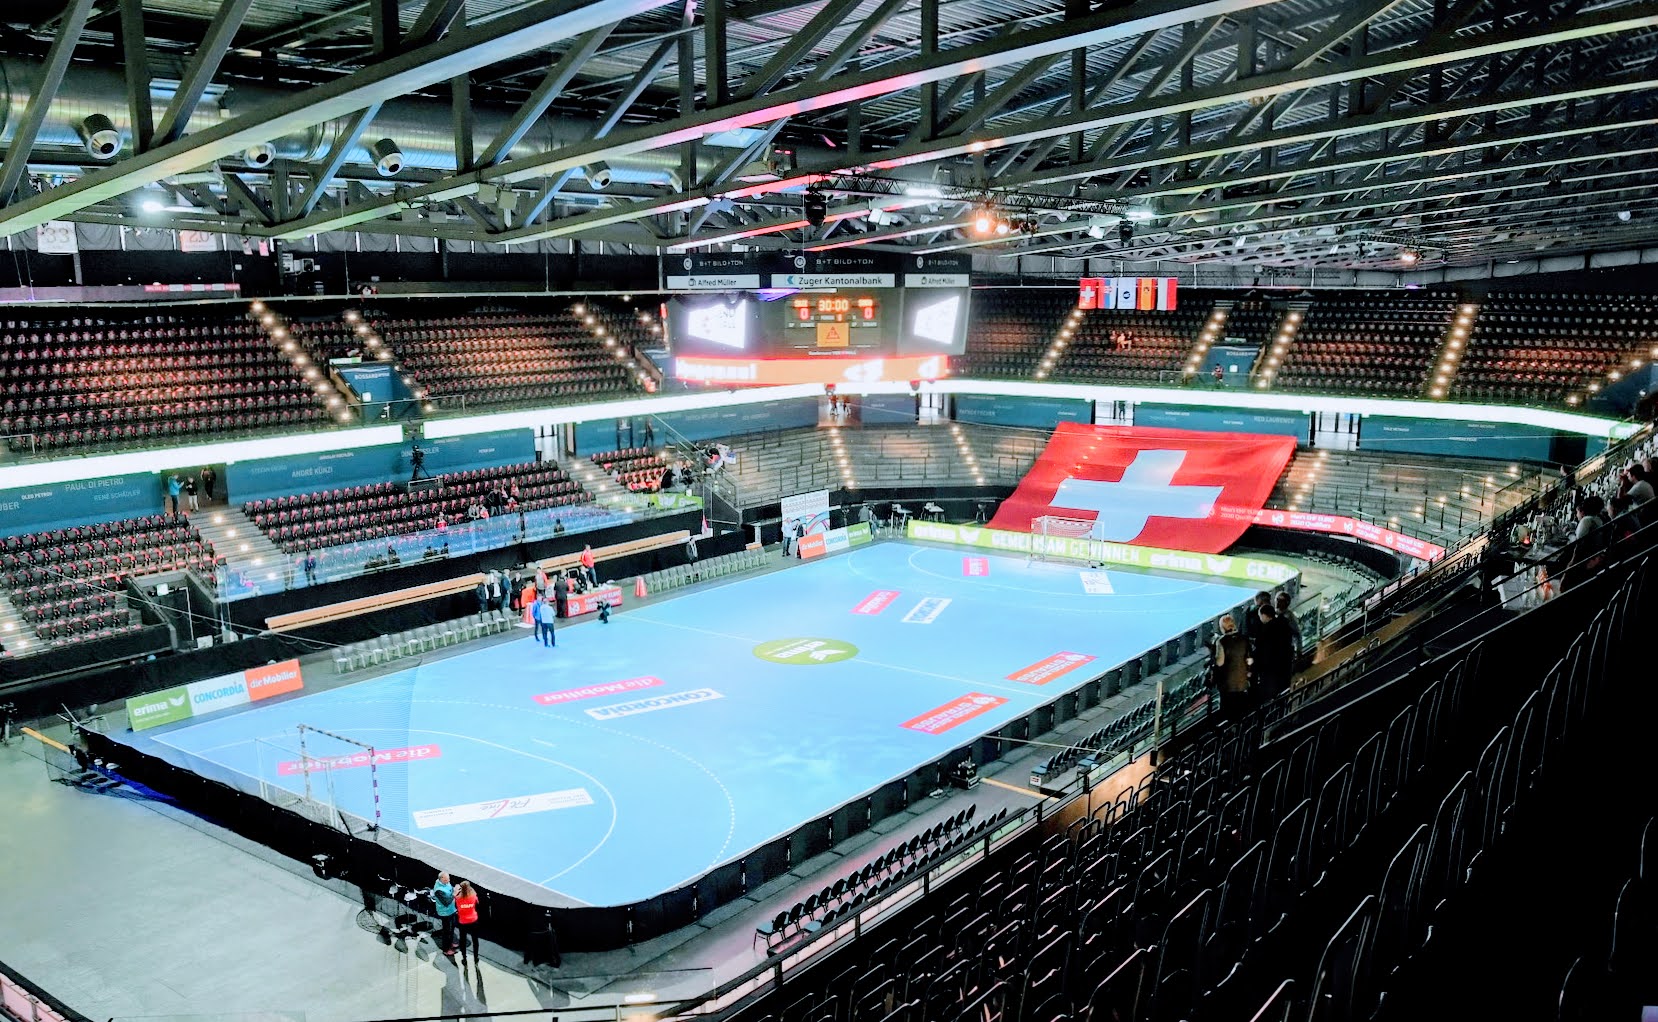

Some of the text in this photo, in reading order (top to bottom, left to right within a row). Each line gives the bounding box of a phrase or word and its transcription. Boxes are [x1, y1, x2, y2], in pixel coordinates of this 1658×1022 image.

[697, 278, 737, 287] Alfred Müller
[798, 276, 883, 287] Zuger Kantonalbank
[818, 299, 849, 311] 30:00
[800, 307, 809, 320] 0
[864, 307, 873, 319] 0
[291, 467, 314, 478] ANDRÉ
[65, 482, 87, 492] PAUL
[97, 477, 124, 488] PIETRO
[991, 531, 1067, 554] GEMEINSAM
[249, 670, 298, 689] die Mobiliar
[543, 677, 653, 702] die Mobiliar
[133, 700, 169, 717] erima
